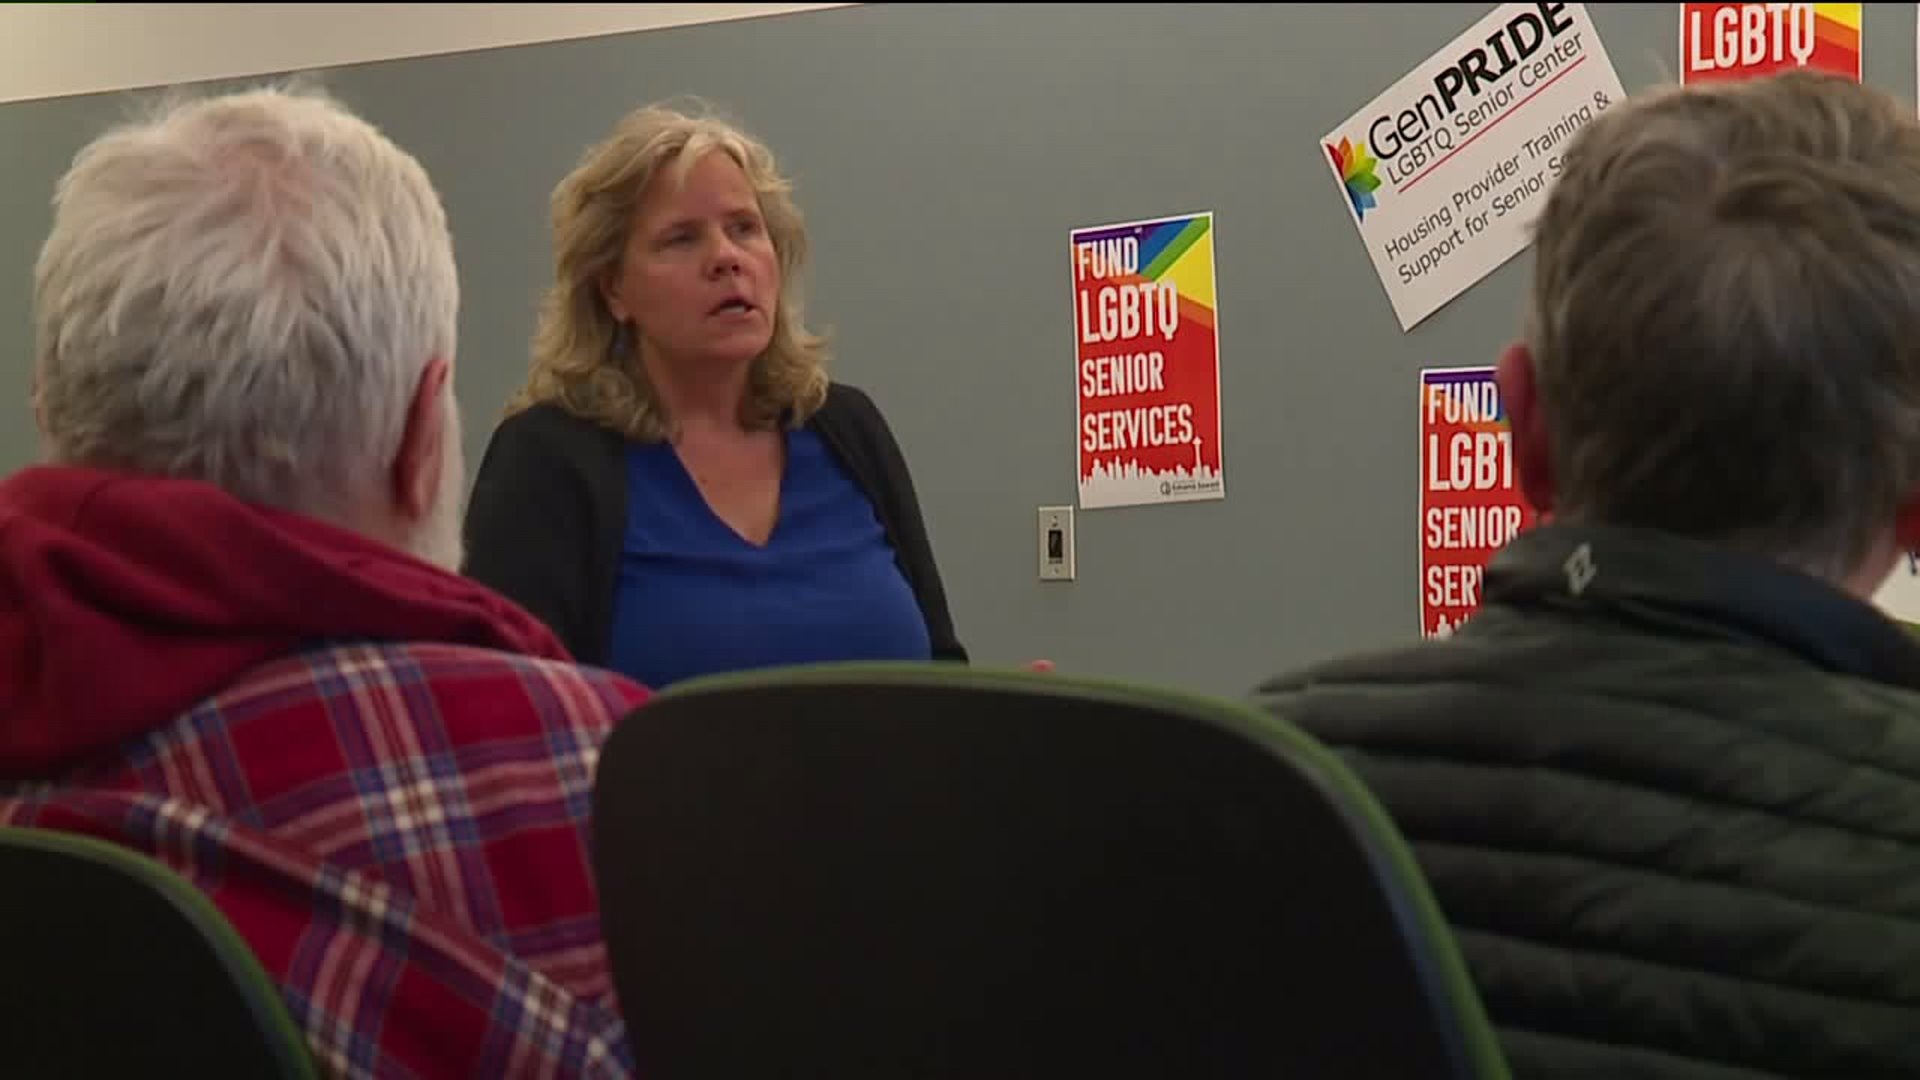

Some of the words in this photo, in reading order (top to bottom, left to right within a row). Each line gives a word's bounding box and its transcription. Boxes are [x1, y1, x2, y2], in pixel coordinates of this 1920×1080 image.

[1691, 3, 1815, 71] LGBTQ
[1368, 3, 1574, 161] GenPRIDE
[1387, 126, 1455, 185] LGBTQ
[1455, 82, 1515, 136] Senior
[1519, 32, 1584, 91] Center
[1384, 205, 1453, 261] Housing
[1452, 153, 1521, 212] Provider
[1522, 102, 1593, 161] Training
[1595, 90, 1611, 111] &
[1078, 236, 1139, 281] FUND
[1398, 229, 1465, 285] Support
[1465, 212, 1490, 239] for
[1492, 170, 1545, 217] Senior
[1080, 280, 1179, 343] LGBTQ
[1082, 352, 1164, 398] SENIOR
[1427, 381, 1498, 424] FUND
[1428, 431, 1513, 491] LGBT
[1427, 506, 1521, 549] SENIOR
